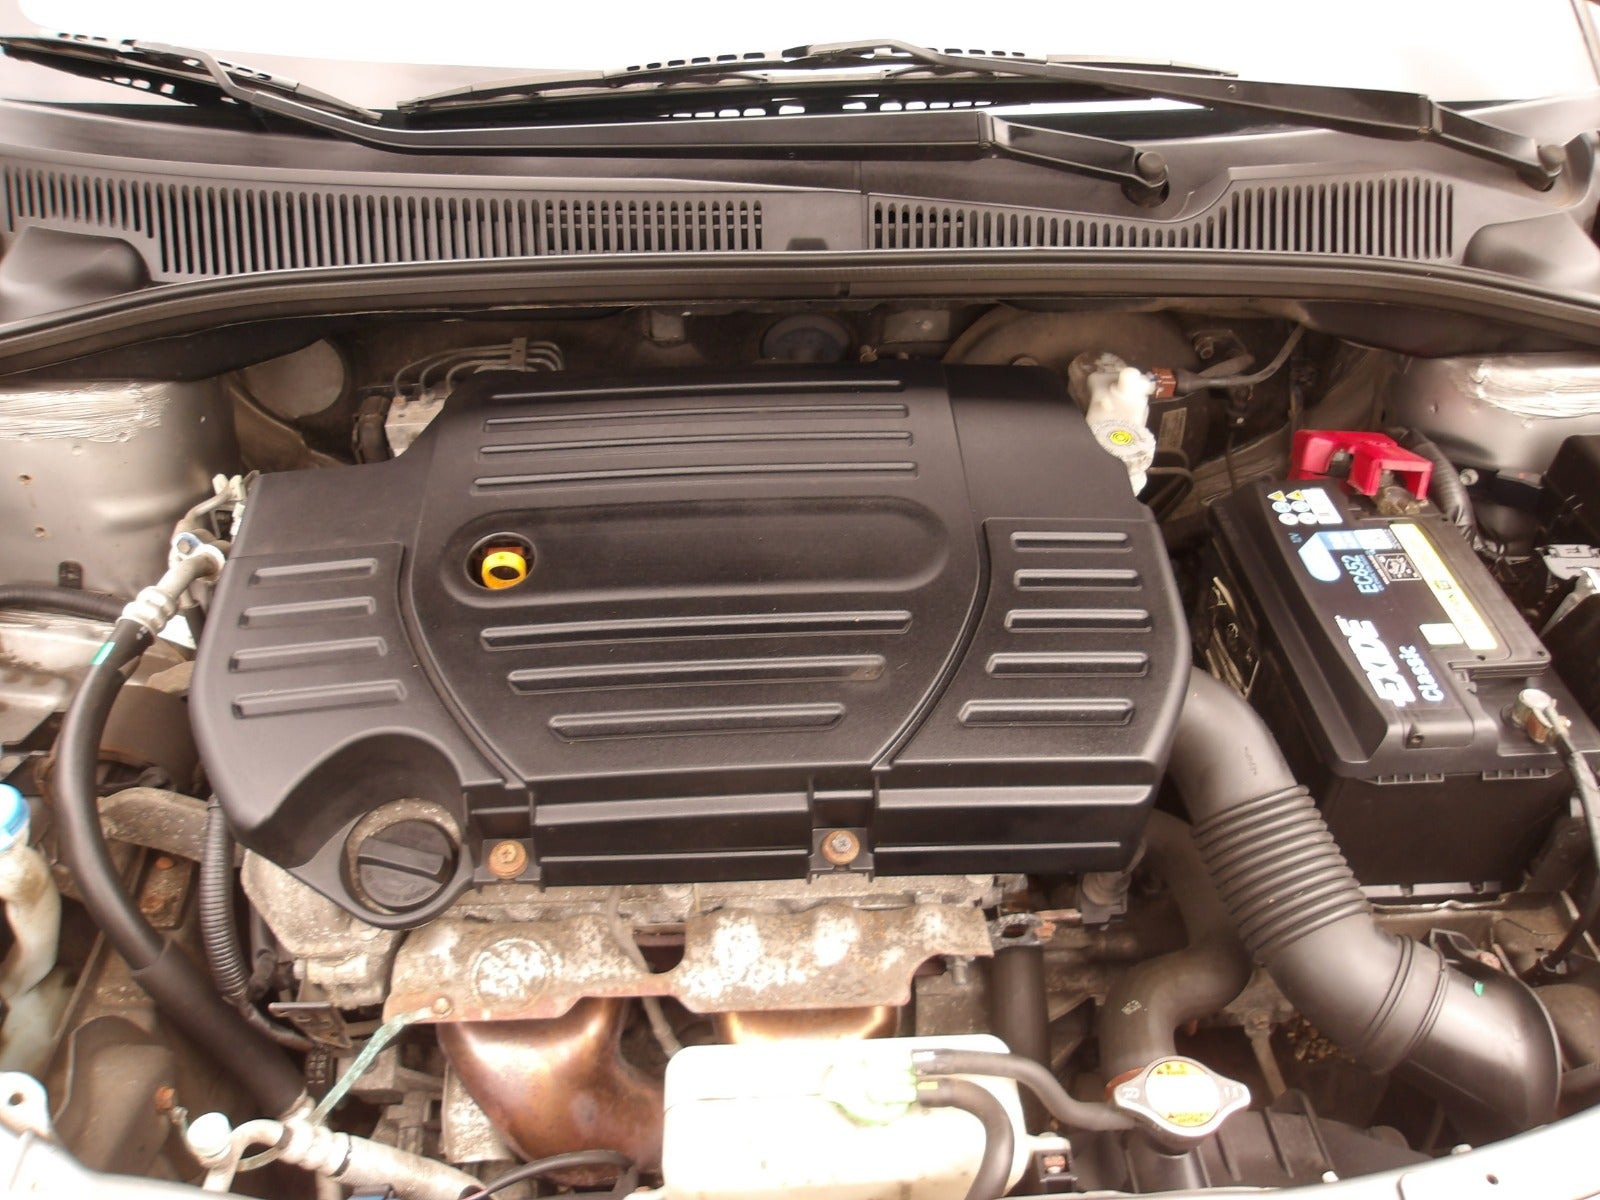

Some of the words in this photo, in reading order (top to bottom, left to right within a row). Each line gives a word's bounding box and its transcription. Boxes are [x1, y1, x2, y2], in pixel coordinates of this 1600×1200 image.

[1341, 555, 1380, 594] EC652
[1338, 618, 1416, 707] EXIDE
[1399, 645, 1444, 702] Classic
